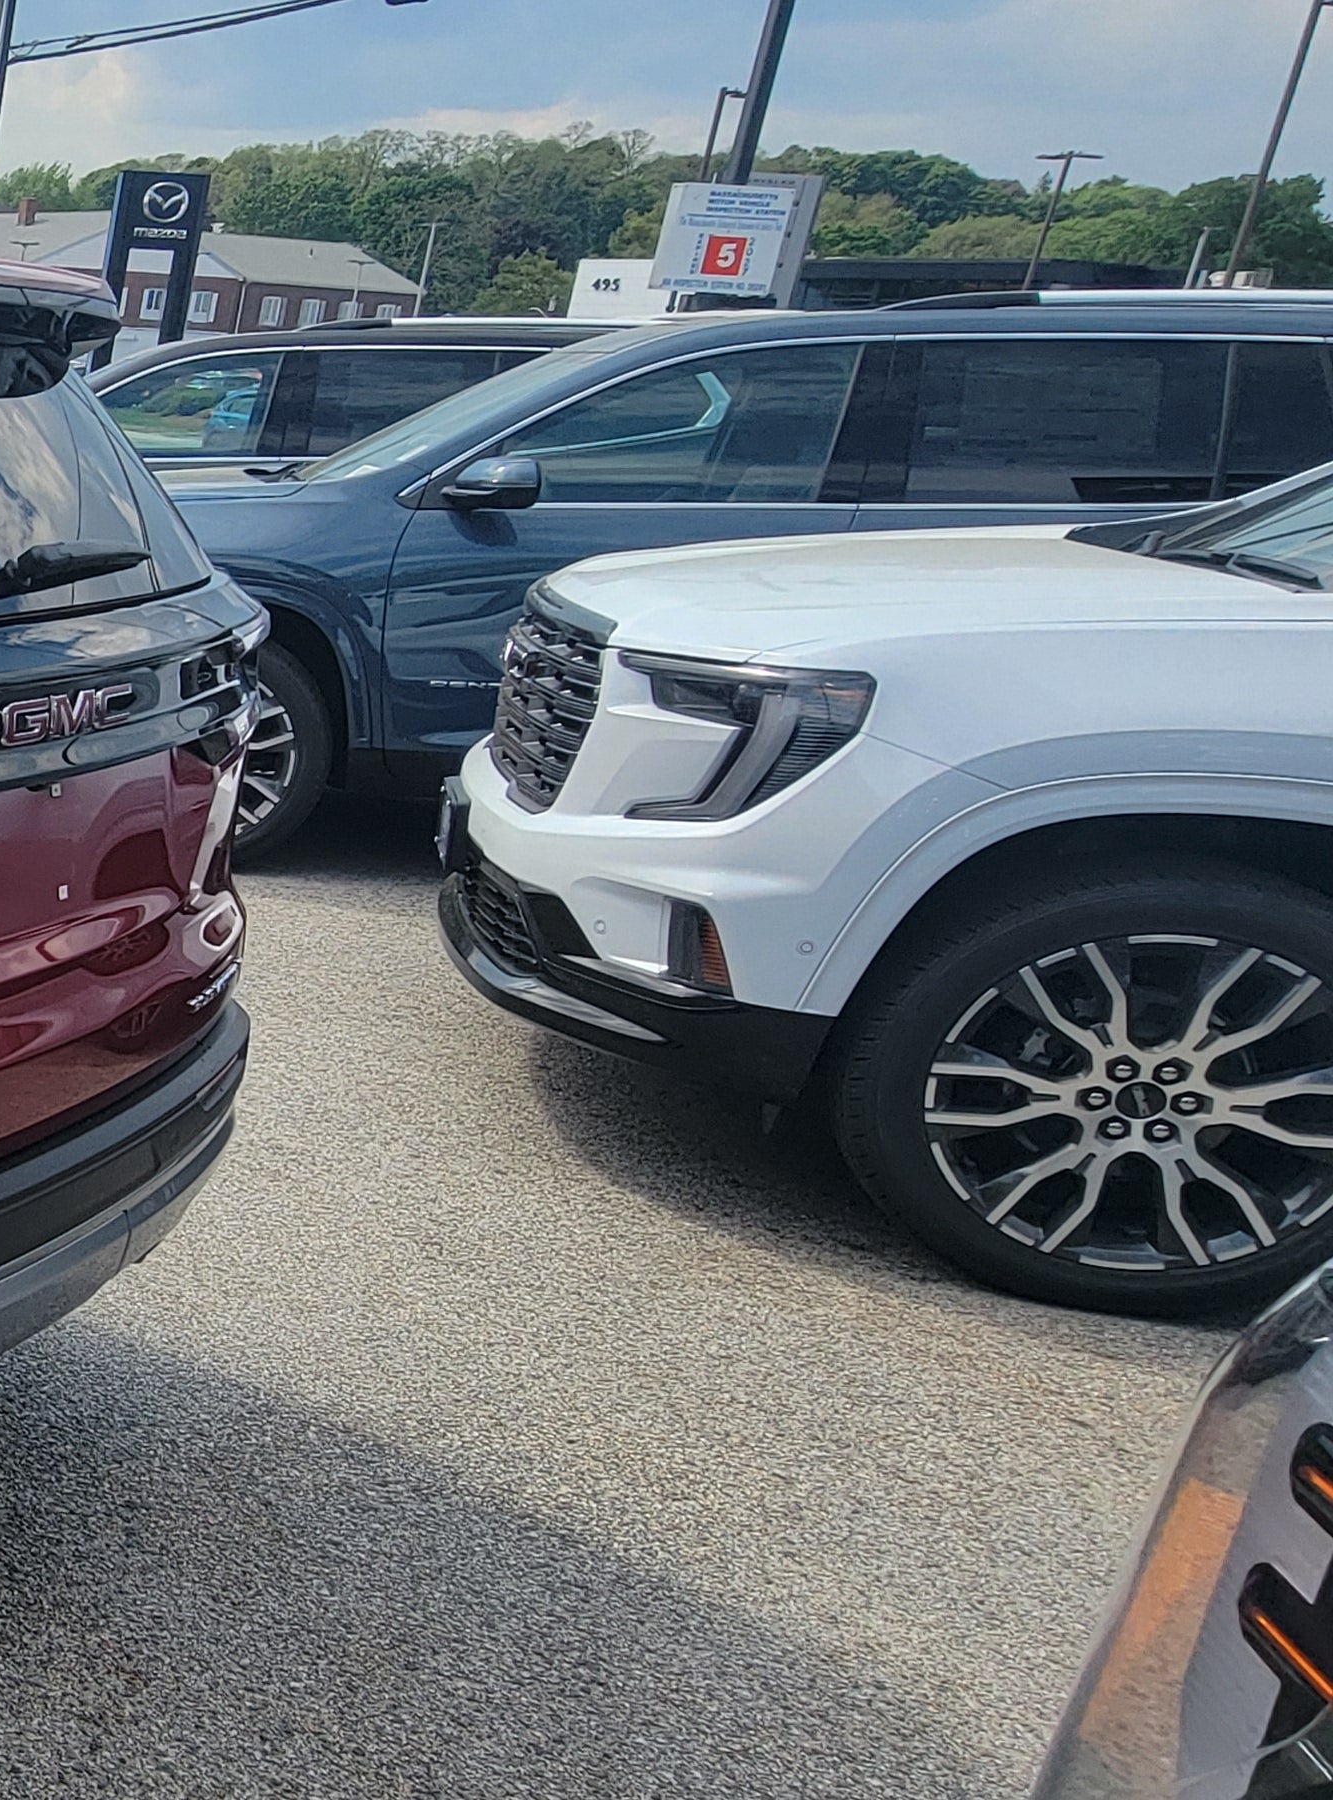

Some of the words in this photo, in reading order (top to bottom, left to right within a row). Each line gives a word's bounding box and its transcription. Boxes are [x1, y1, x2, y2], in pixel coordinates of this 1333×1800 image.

[133, 227, 188, 240] mazda
[715, 242, 738, 269] 5
[591, 278, 621, 292] 495
[0, 682, 133, 747] GMC
